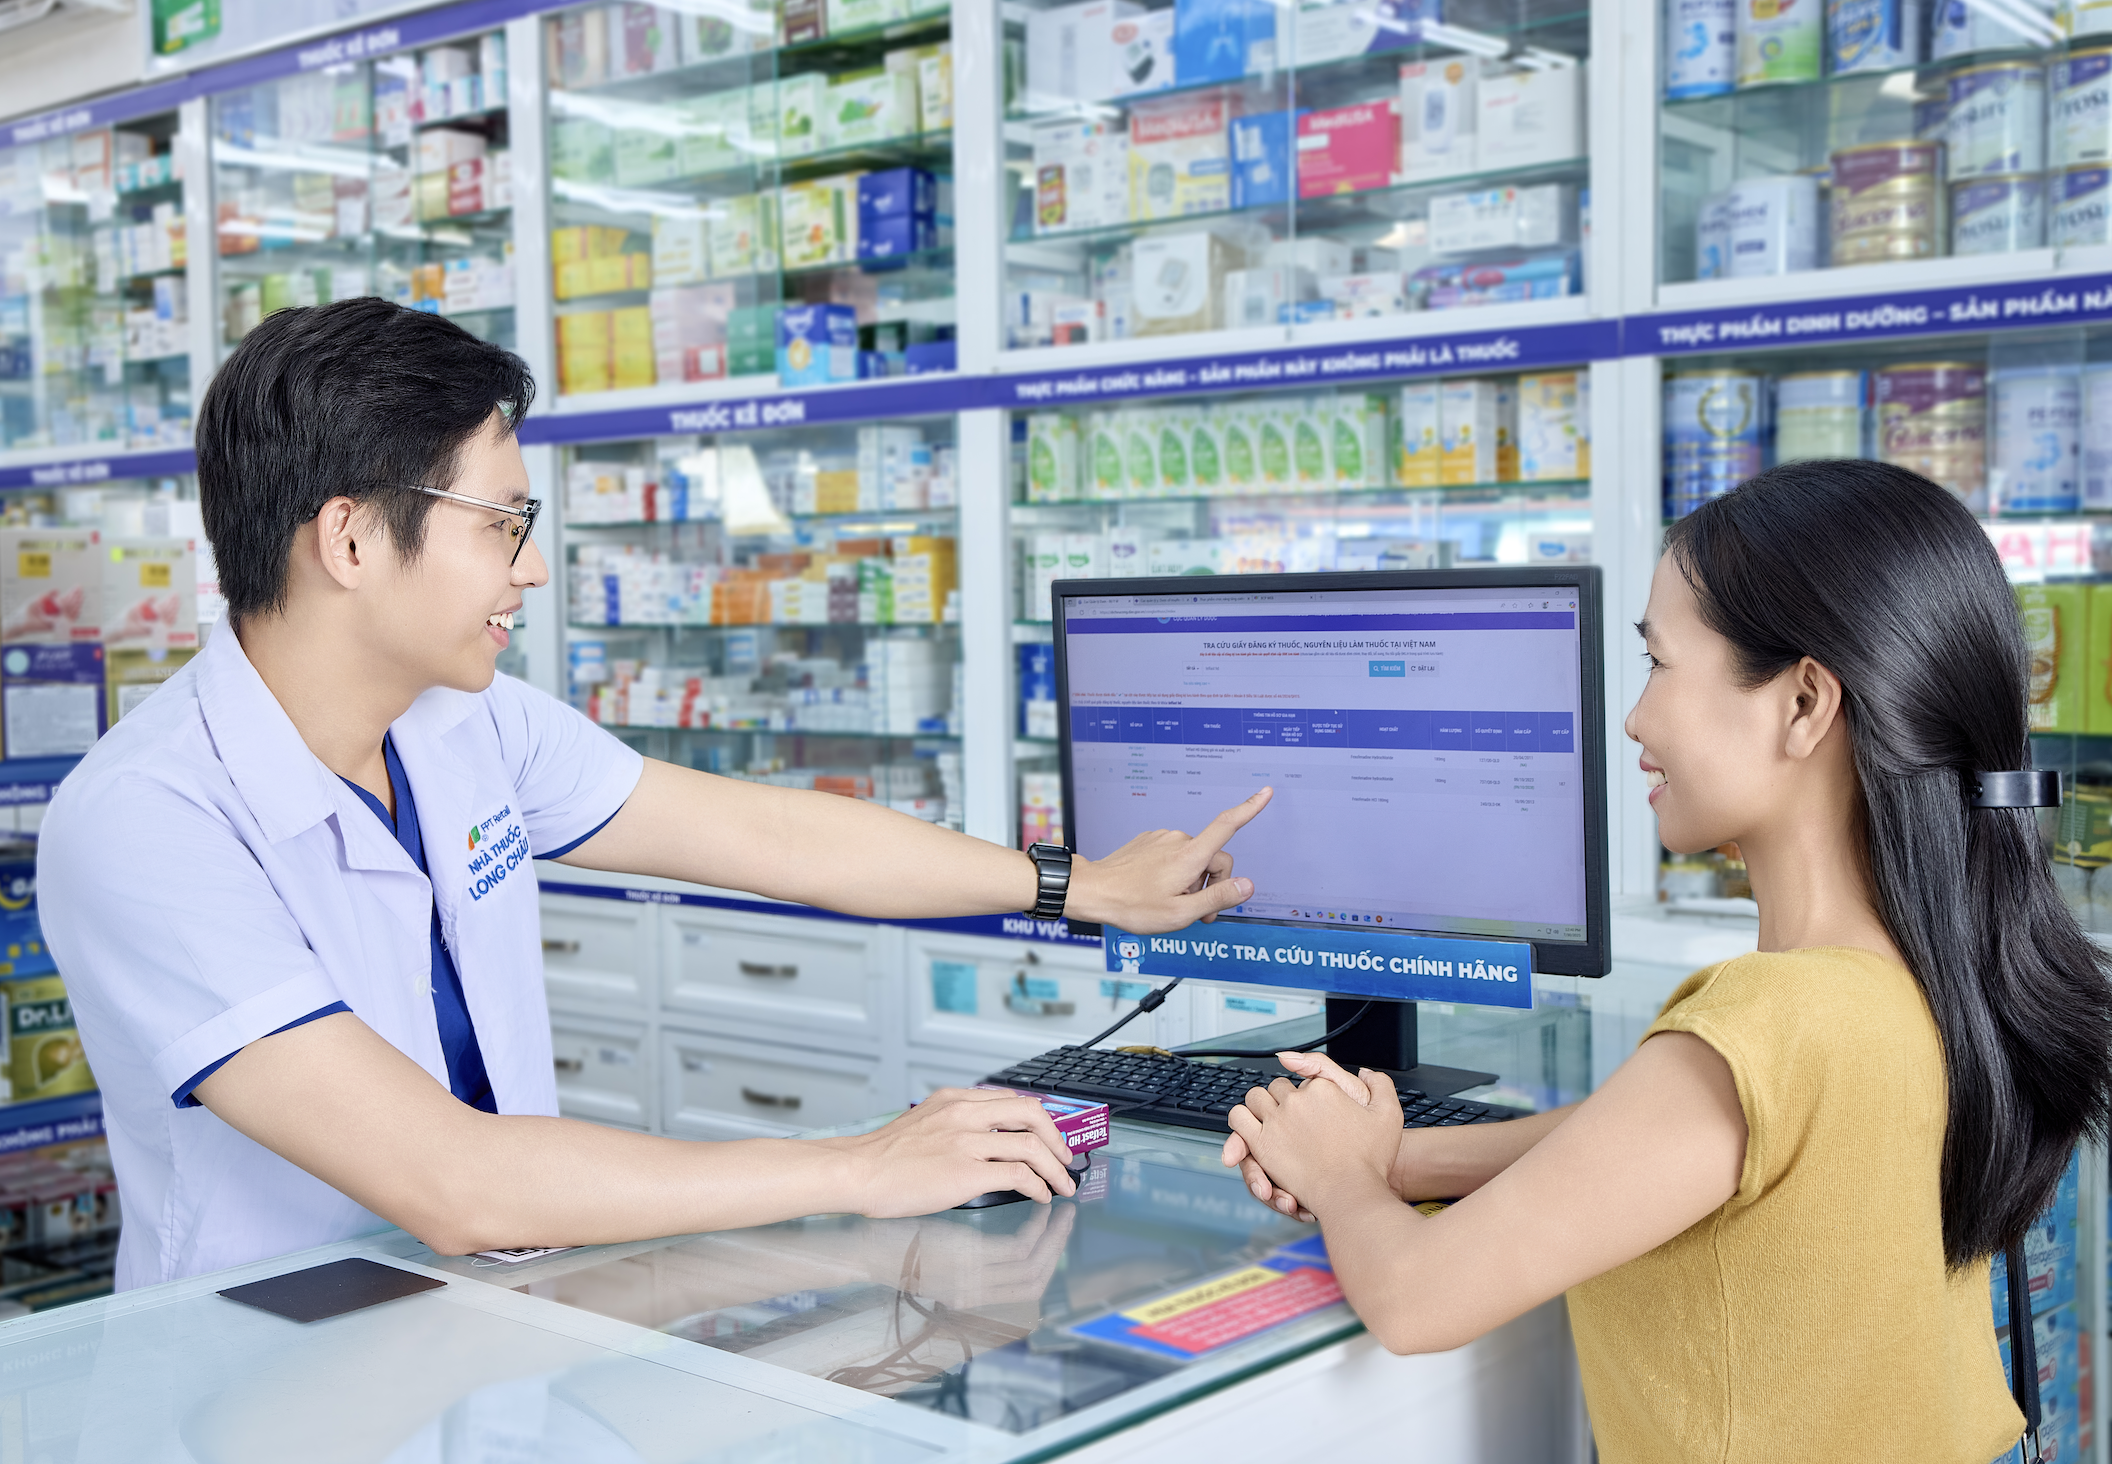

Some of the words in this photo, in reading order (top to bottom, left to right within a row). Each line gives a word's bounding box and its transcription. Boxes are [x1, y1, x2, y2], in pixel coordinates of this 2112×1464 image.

[1660, 322, 1714, 346] THỰC
[1719, 313, 1780, 341] PHẨM
[1786, 315, 1840, 333] DINH
[1846, 305, 1928, 329] DƯỠNG
[1950, 295, 1998, 322] SẢN
[2004, 288, 2076, 316] PHẨM
[1322, 352, 1380, 373] KHÔNG
[1385, 345, 1426, 367] PHẢI
[1430, 343, 1454, 364] LÀ
[1457, 337, 1519, 360] THUỐC
[671, 404, 730, 430] THUỐC
[763, 399, 804, 422] ĐƠN
[1217, 640, 1231, 649] CỨU
[1232, 640, 1247, 649] GIẤY
[1248, 641, 1267, 649] ĐĂNG
[1268, 640, 1276, 649] KÝ
[1278, 640, 1302, 650] THUỐC,
[1304, 640, 1331, 648] NGUYÊN
[1333, 640, 1347, 649] LIỆU
[1349, 640, 1364, 648] LÀM
[1365, 638, 1389, 648] THUỐC
[1390, 641, 1401, 649] TẠI
[1403, 640, 1418, 650] VIỆT
[480, 817, 495, 833] FPT
[492, 804, 511, 824] Retail
[468, 849, 493, 875] NHÀ
[490, 823, 521, 857] THUỐC
[468, 864, 506, 902] LONG
[506, 836, 529, 871] CHÂU
[1002, 918, 1035, 936] KHU
[1036, 920, 1068, 941] VỰC
[1150, 937, 1187, 957] KHU
[1191, 940, 1229, 962] VỰC
[1232, 944, 1271, 964] TRA
[1274, 943, 1314, 967] CỨU
[1318, 949, 1385, 972] THUỐC
[1389, 955, 1453, 978] CHÍNH
[1458, 959, 1519, 983] HÃNG
[1068, 1134, 1081, 1148] HD
[1082, 1127, 1108, 1143] Telfast
